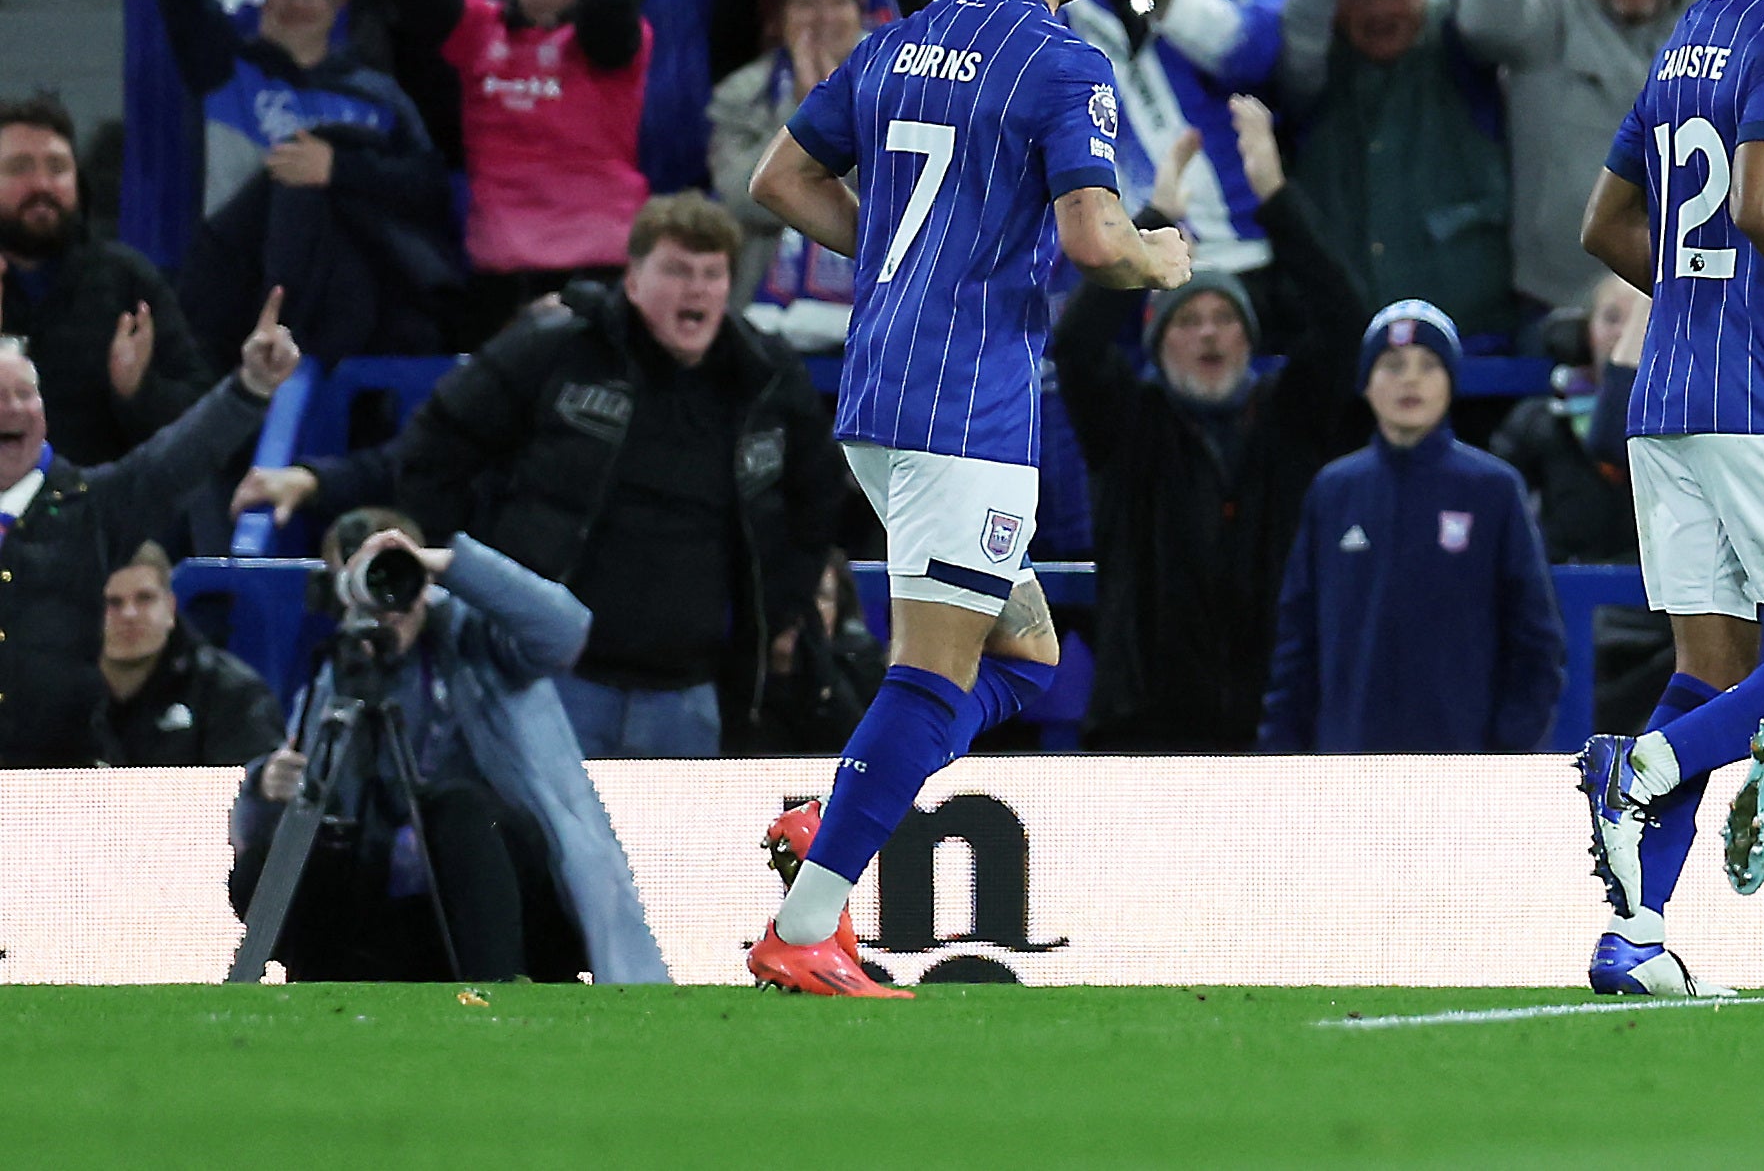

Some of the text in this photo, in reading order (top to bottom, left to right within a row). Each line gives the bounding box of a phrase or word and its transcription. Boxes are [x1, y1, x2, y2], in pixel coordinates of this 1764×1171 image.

[893, 43, 982, 82] BURNS
[877, 119, 956, 283] 7
[1653, 117, 1737, 284] 12
